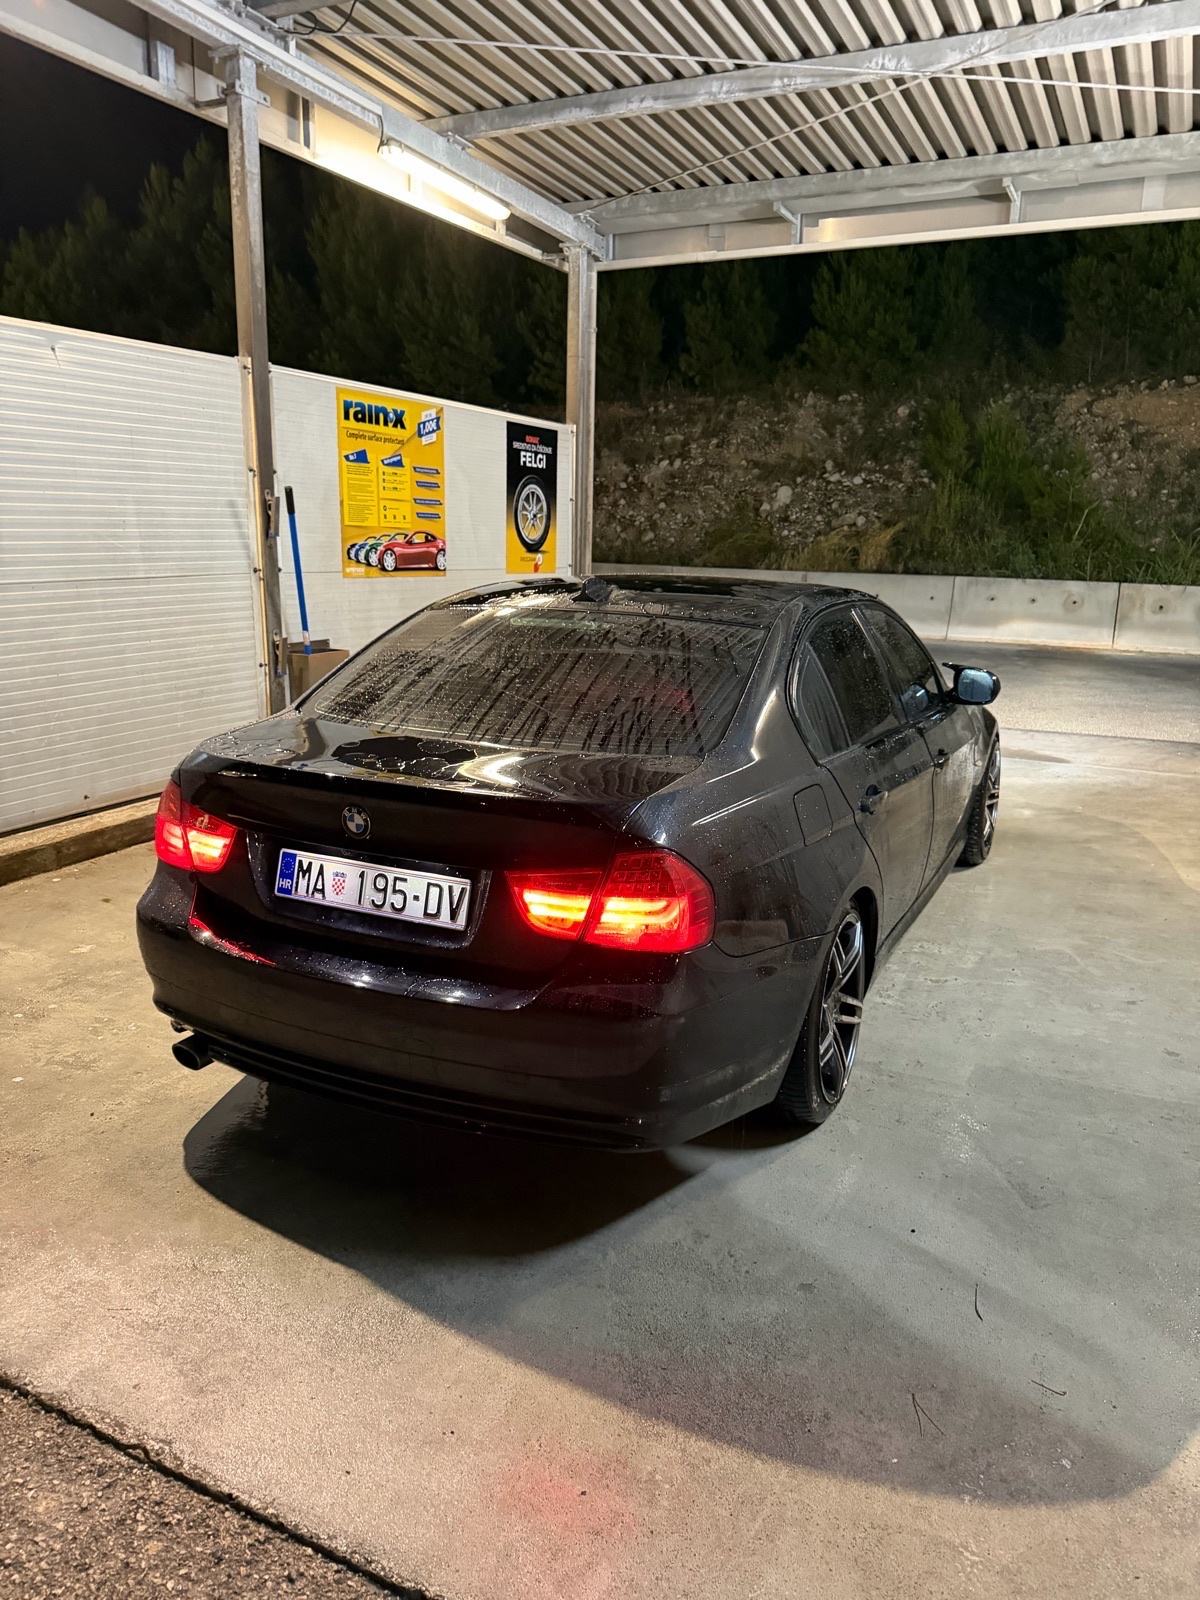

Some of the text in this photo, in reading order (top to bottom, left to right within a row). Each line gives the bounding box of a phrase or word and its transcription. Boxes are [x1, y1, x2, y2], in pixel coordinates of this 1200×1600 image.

[346, 430, 367, 440] Complete
[520, 451, 546, 469] FELGI
[279, 877, 292, 890] HR
[294, 859, 327, 900] MA
